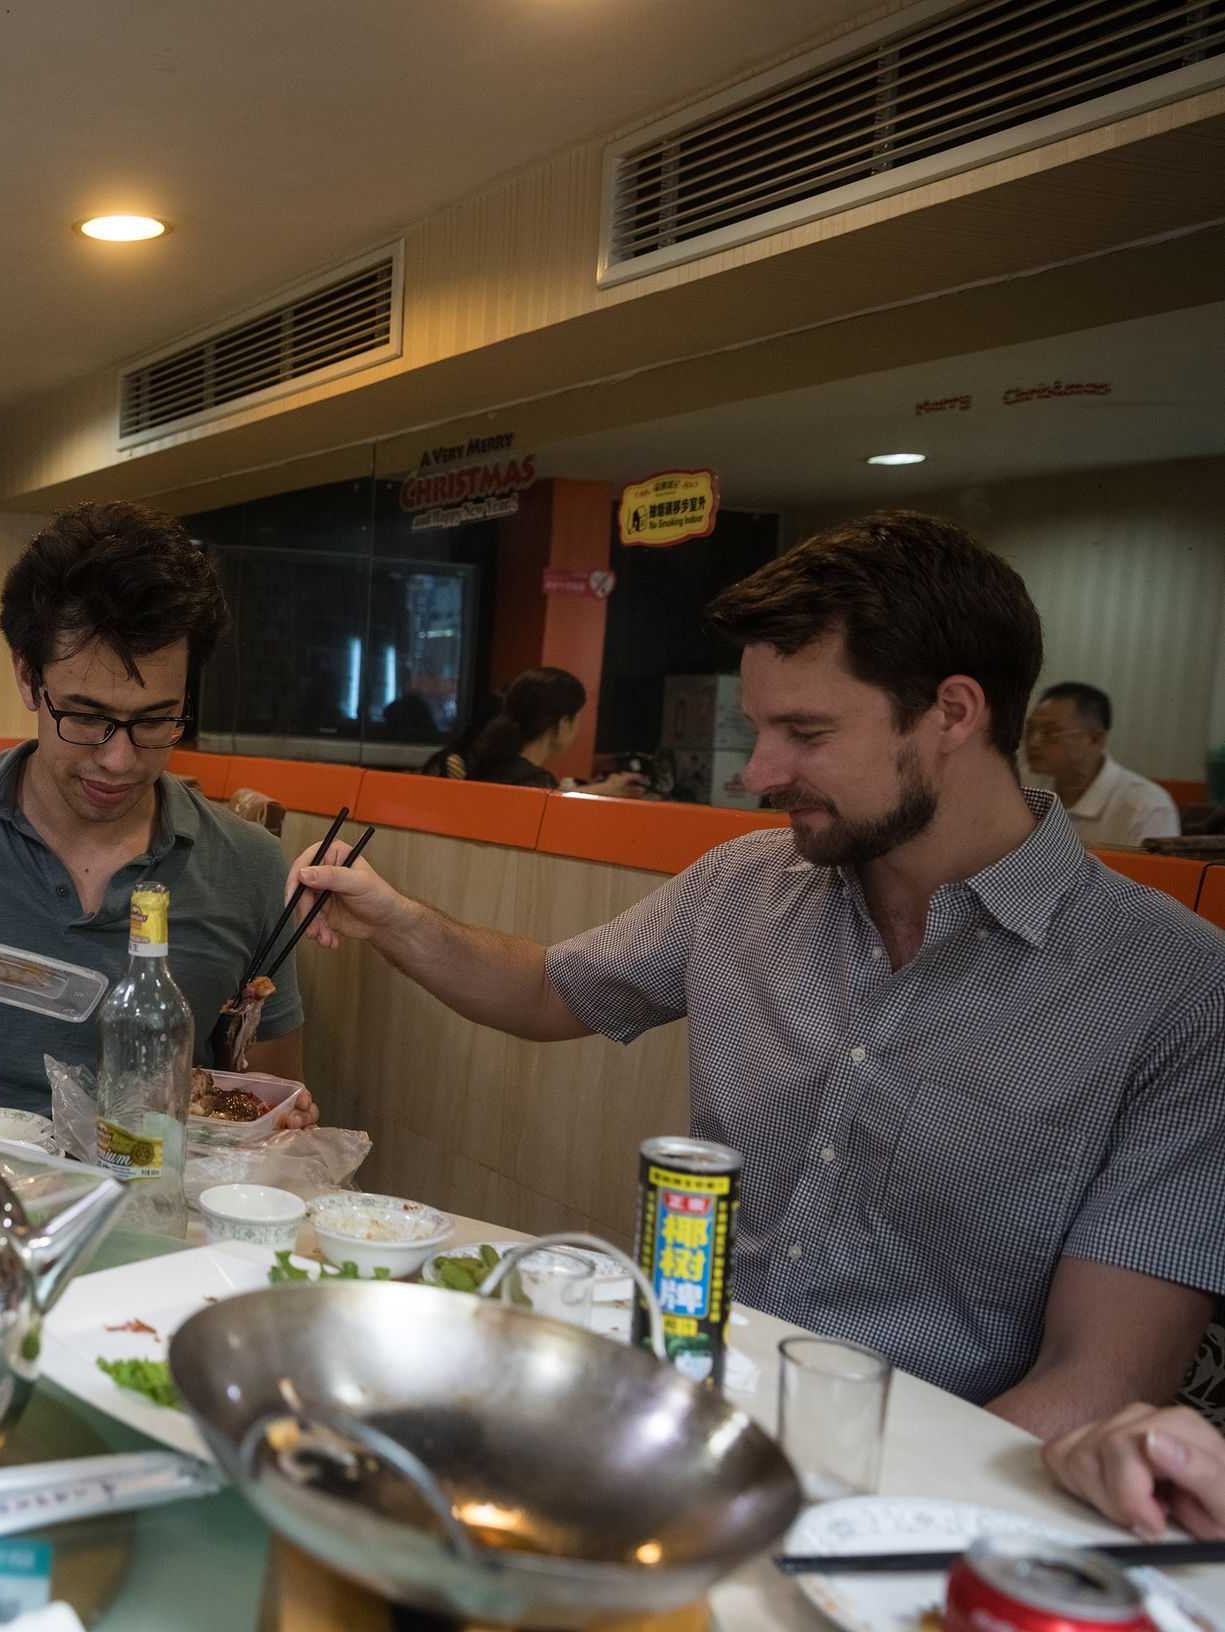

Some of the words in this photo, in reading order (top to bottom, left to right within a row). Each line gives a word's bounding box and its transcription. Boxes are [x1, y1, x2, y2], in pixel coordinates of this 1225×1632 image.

[420, 451, 431, 467] A
[432, 445, 464, 463] VERY
[466, 433, 514, 455] MERRY
[402, 453, 536, 508] CHRISTMAS
[649, 521, 657, 529] No
[658, 518, 683, 528] Smoking
[685, 515, 703, 525] Indoor
[659, 1213, 709, 1315] 椰树牌
